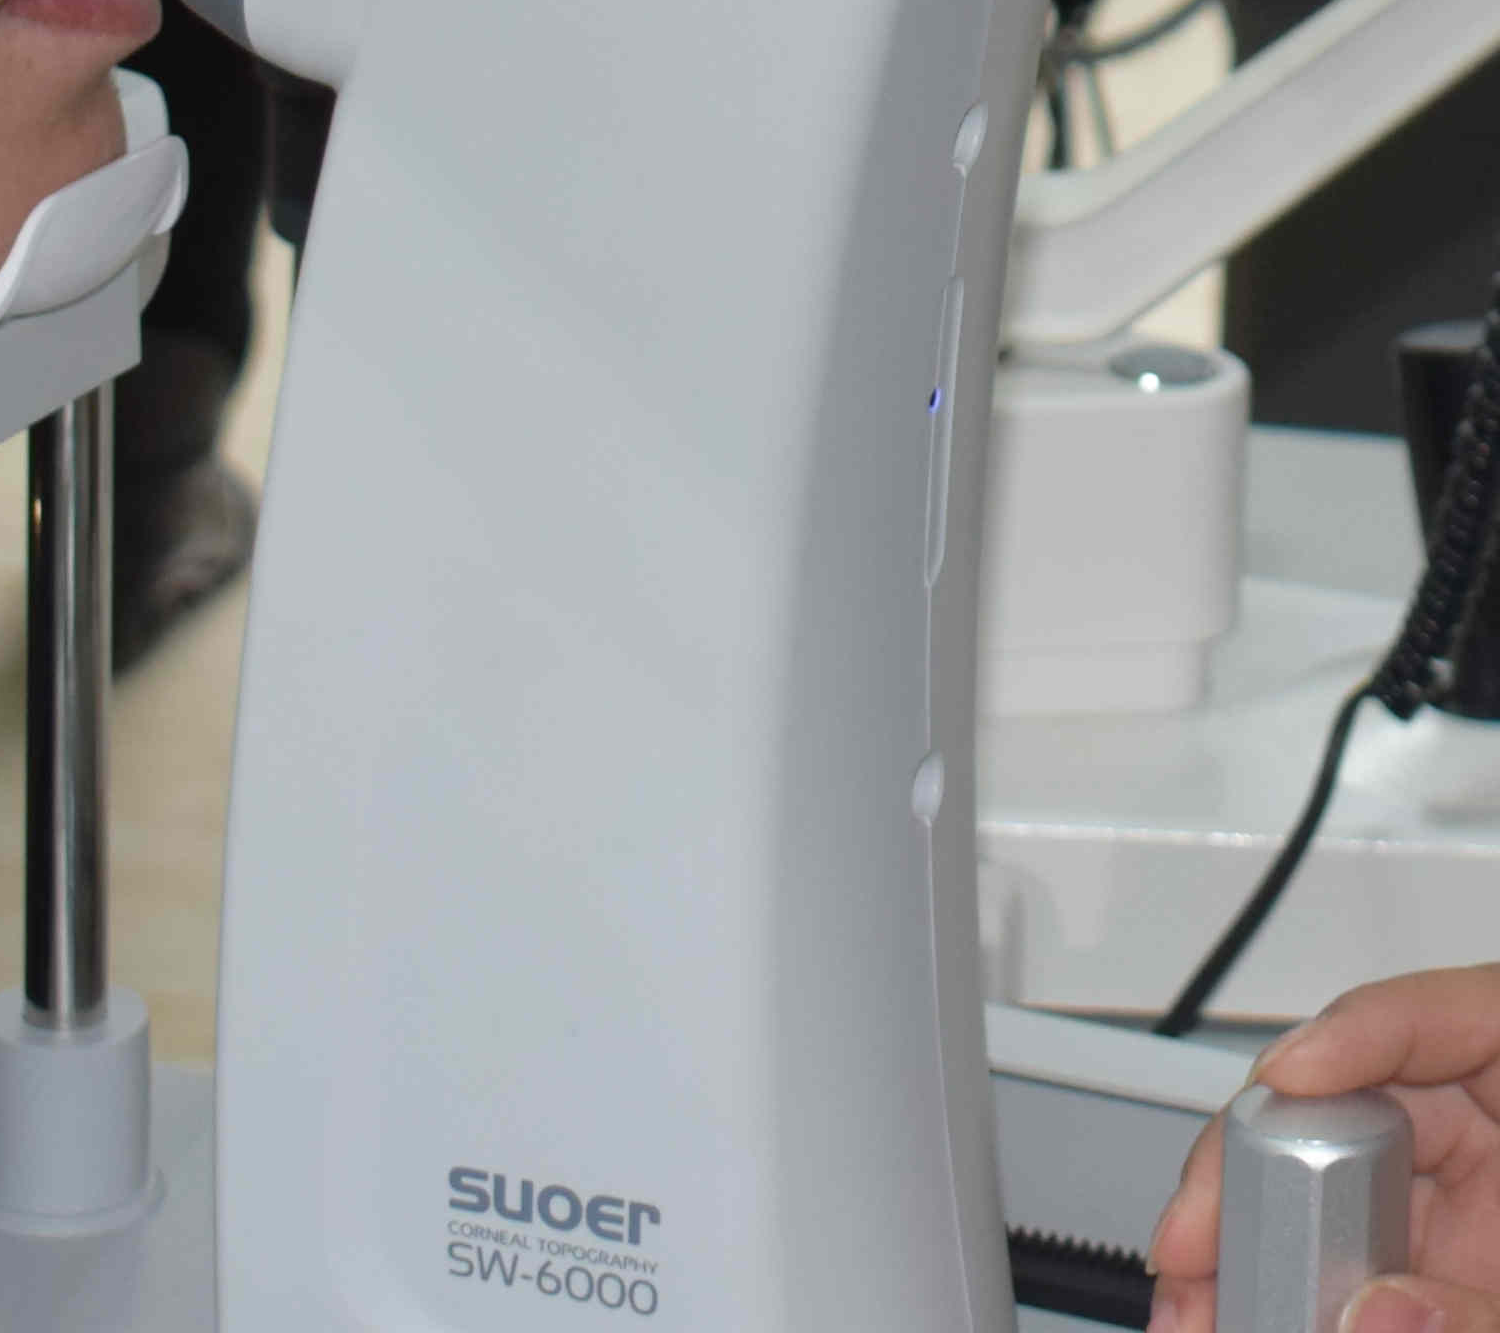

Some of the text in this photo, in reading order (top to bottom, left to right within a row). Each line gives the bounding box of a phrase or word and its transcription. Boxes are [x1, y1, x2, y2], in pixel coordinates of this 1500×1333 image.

[447, 1219, 659, 1275] CORNEAL TOPOGRAPHY
[447, 1241, 659, 1316] SW-6000
